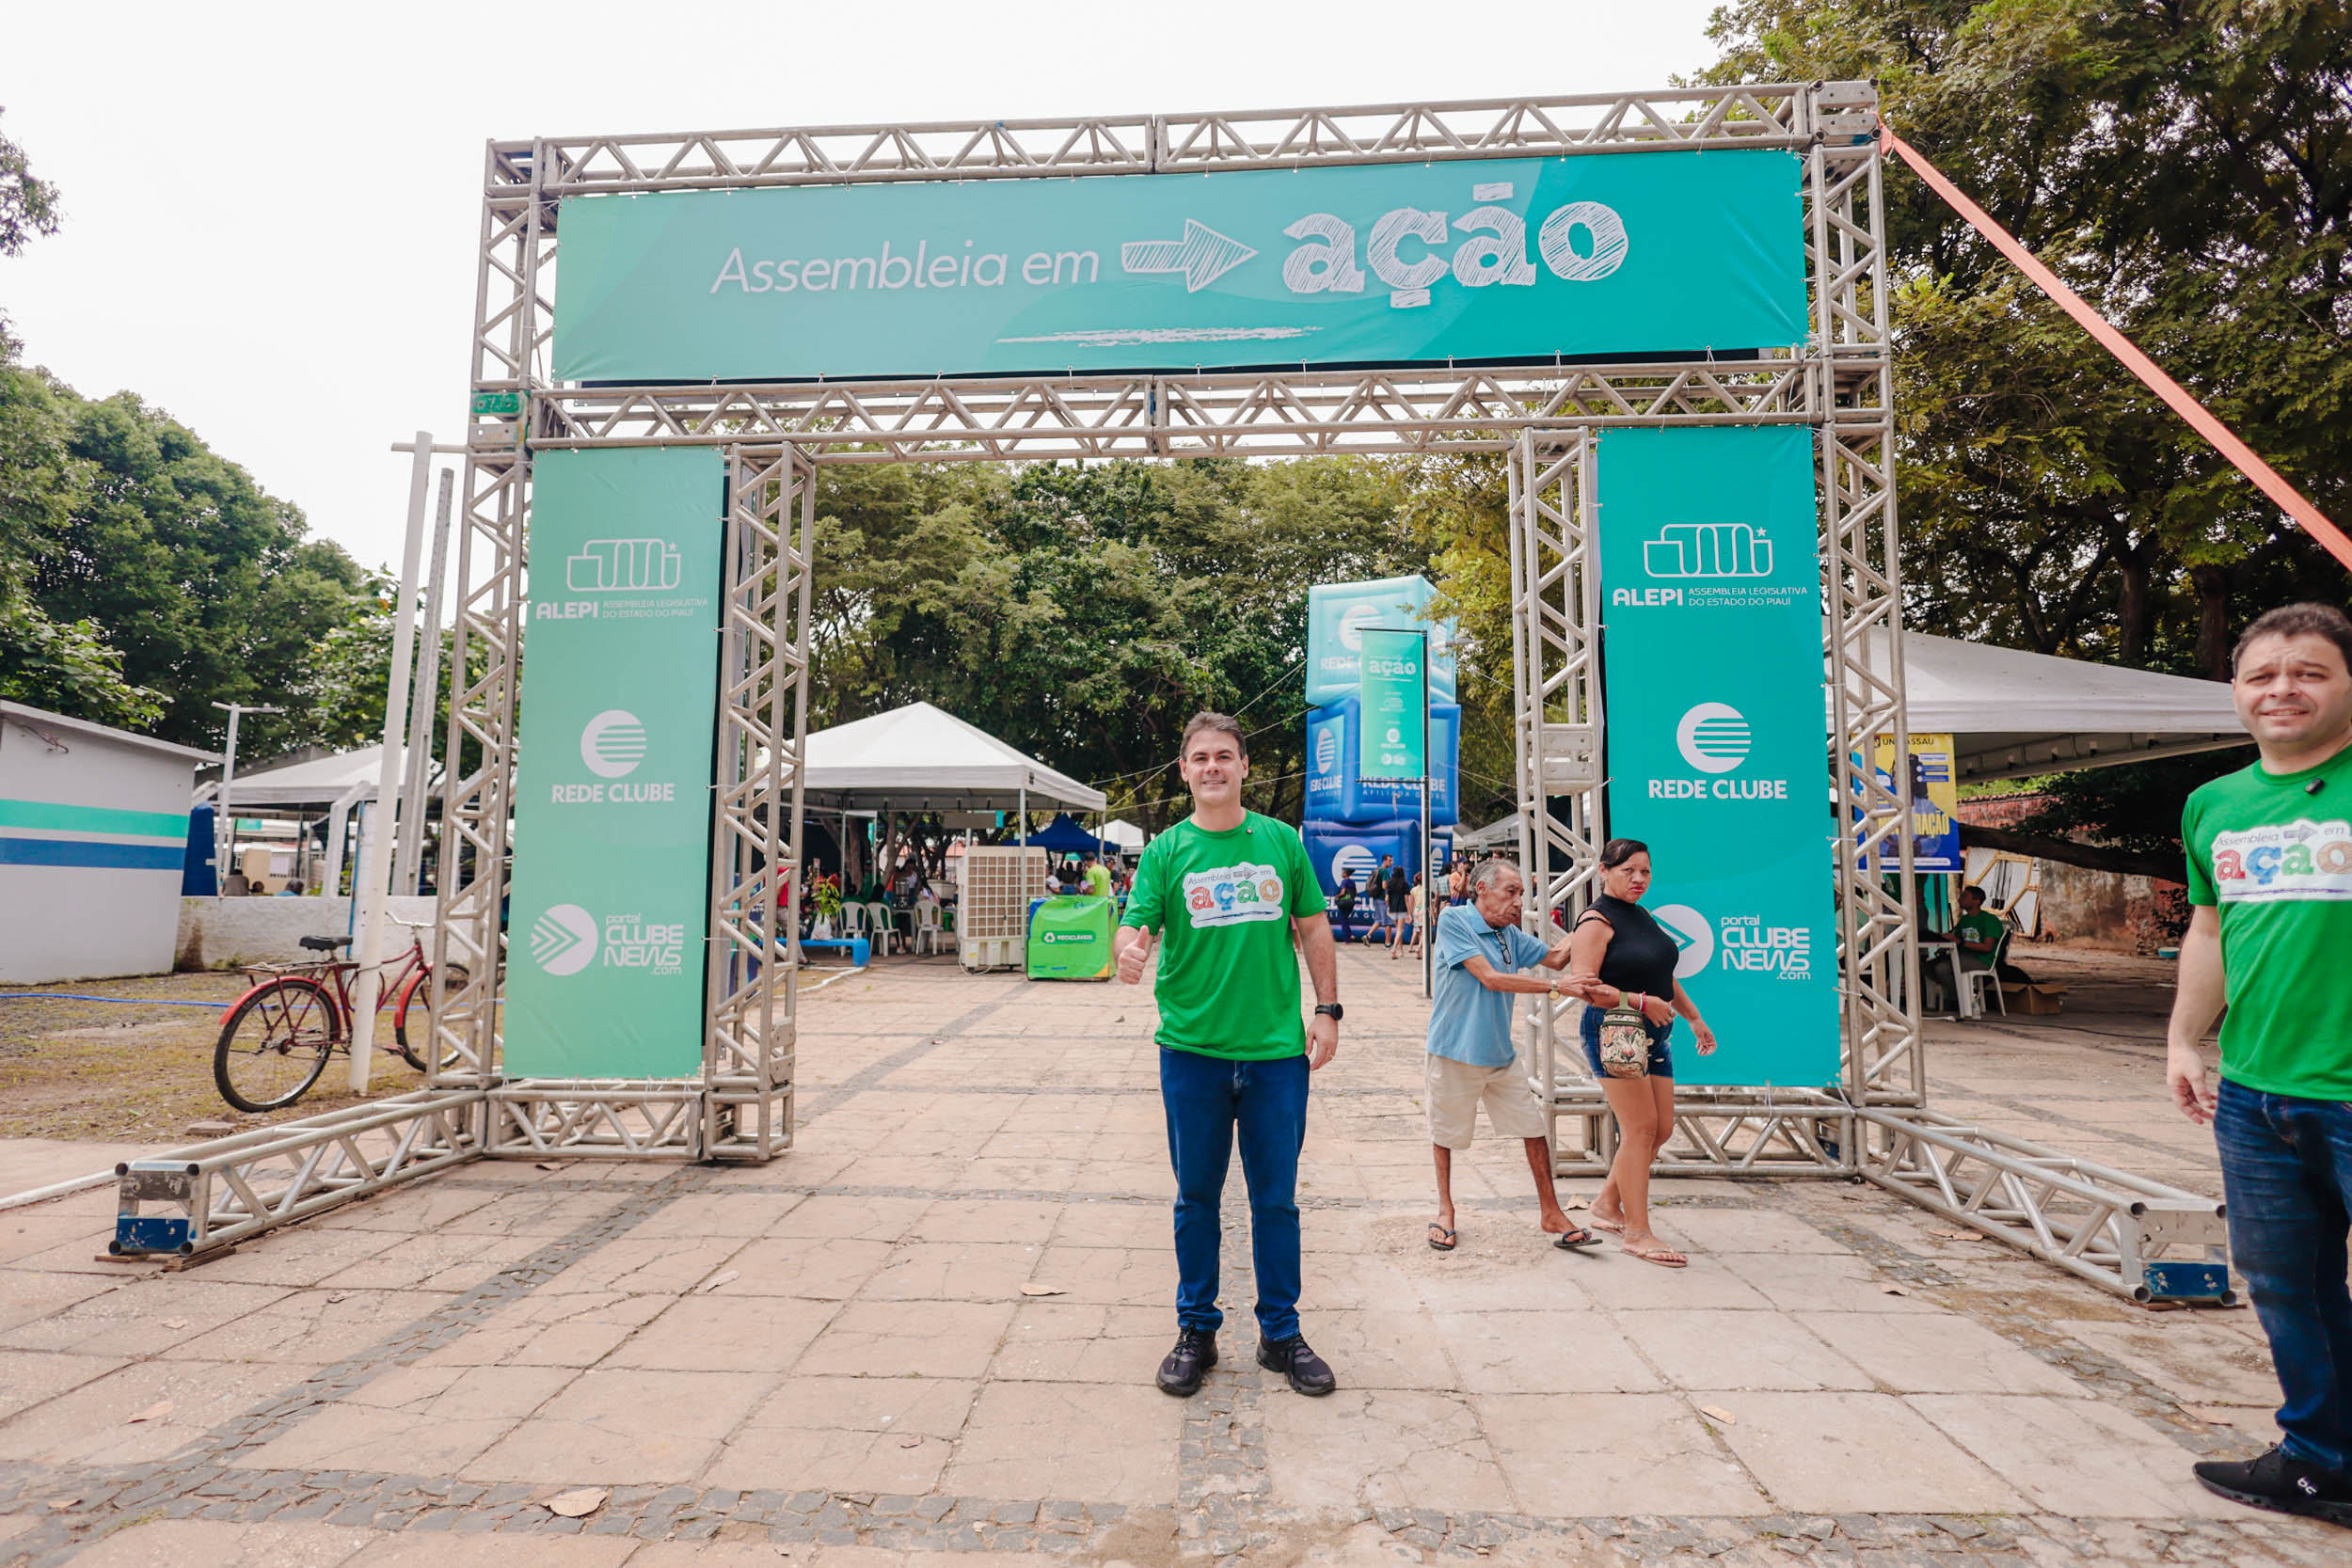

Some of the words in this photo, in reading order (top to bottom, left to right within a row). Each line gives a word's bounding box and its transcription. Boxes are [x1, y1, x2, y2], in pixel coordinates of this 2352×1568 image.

[1281, 182, 1629, 309] ação
[709, 239, 1009, 293] Assembleia
[1022, 250, 1100, 285] em
[1612, 587, 1684, 607] ALEPI
[1688, 587, 1747, 595] ASSEMBLEIA
[1749, 586, 1808, 595] LEGISLATIVA
[535, 601, 598, 620] ALEPI
[603, 599, 656, 609] ASSEMBLEIA
[657, 598, 708, 608] LEGISLATIVA
[1688, 597, 1705, 607] DO
[1708, 597, 1746, 606] ESTADO
[1748, 597, 1764, 606] DO
[603, 610, 616, 618] DO
[619, 610, 654, 618] ESTADO
[656, 609, 670, 618] DO
[551, 783, 605, 803] REDE
[608, 782, 675, 803] CLUBE
[1648, 779, 1708, 799] REDE
[1712, 779, 1788, 800] CLUBE
[2216, 832, 2279, 847] Assembleia
[2324, 826, 2344, 835] em
[1187, 872, 1232, 885] Assembleia
[605, 912, 641, 927] portal
[1721, 913, 1760, 928] portal
[605, 925, 685, 945] CLUBE
[1722, 927, 1810, 949] CLUBE
[603, 945, 683, 967] NEWS
[1722, 948, 1810, 971] NEWS
[649, 965, 683, 976] .com
[1776, 971, 1811, 980] .com
